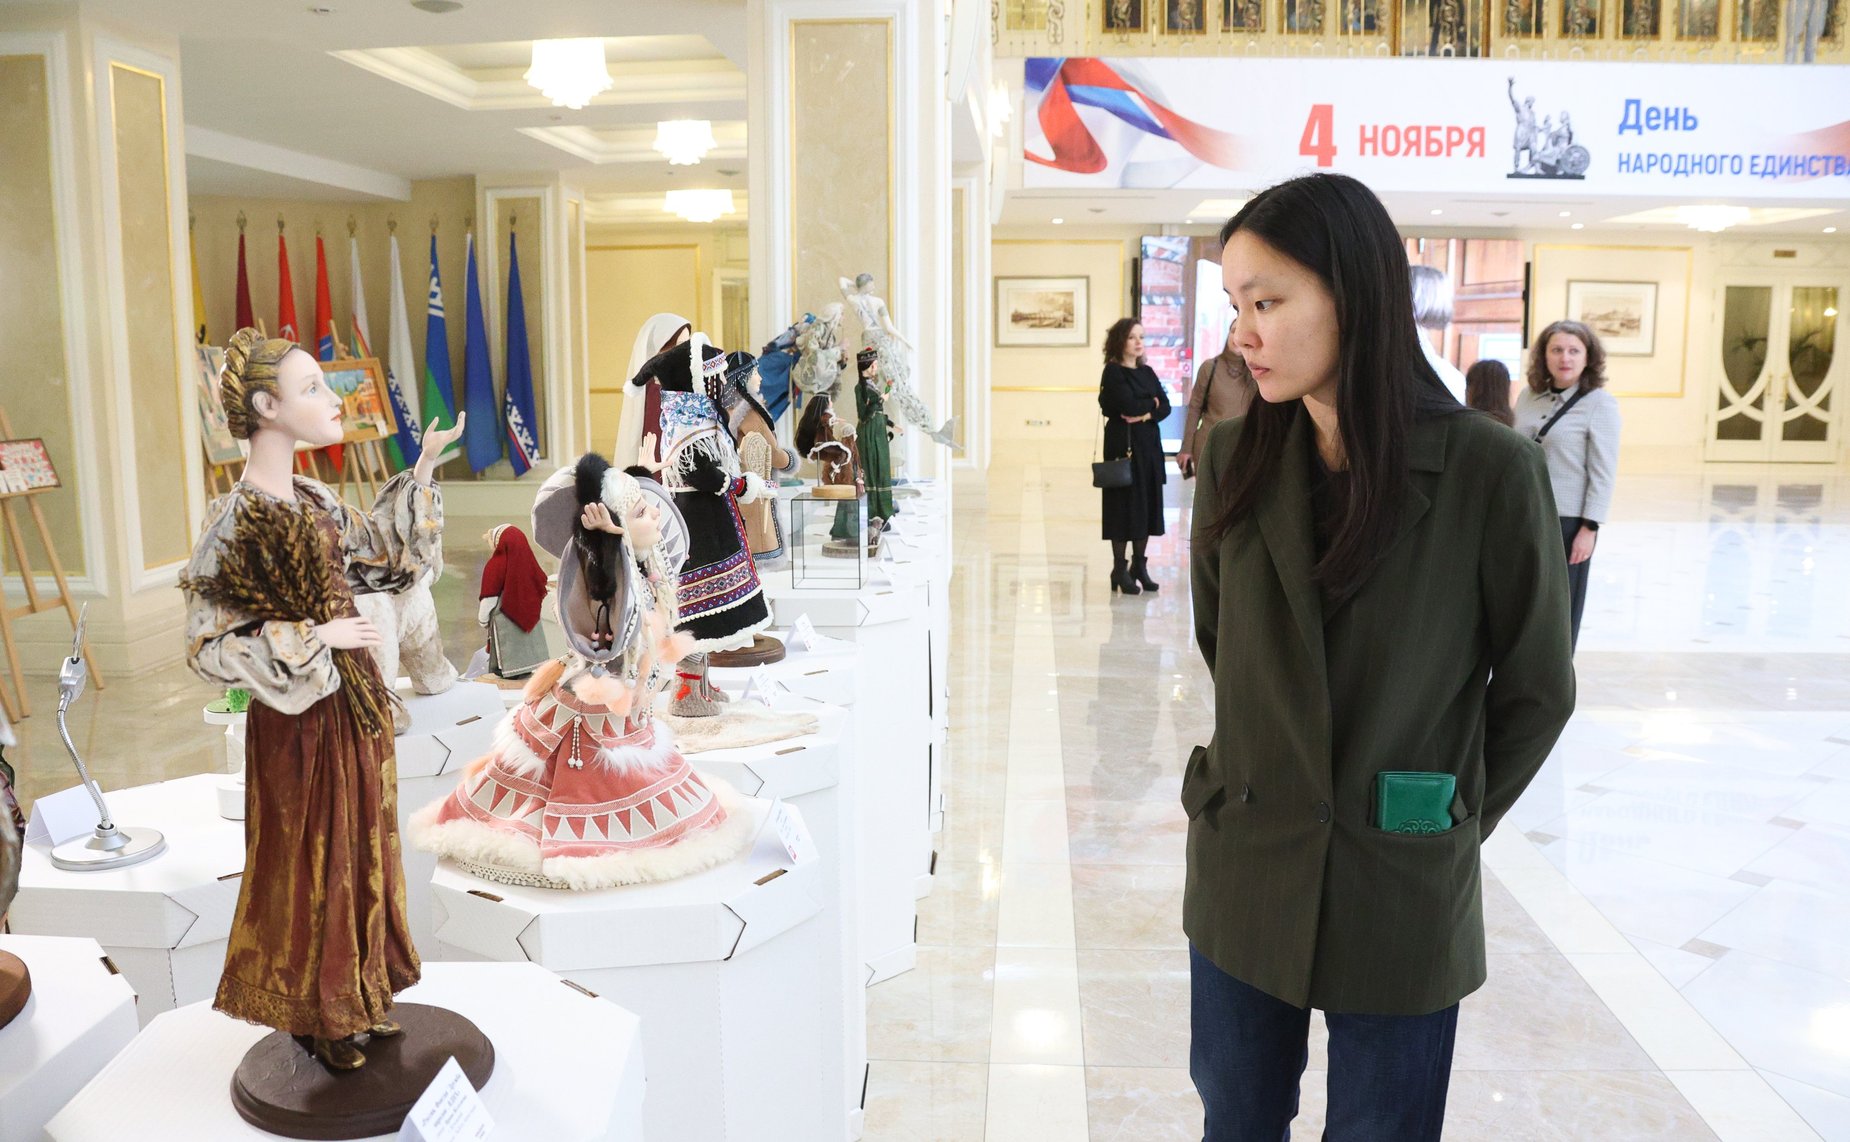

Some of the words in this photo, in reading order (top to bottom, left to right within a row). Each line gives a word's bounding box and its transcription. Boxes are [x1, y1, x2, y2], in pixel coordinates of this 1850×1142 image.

[1299, 104, 1337, 167] 4
[1359, 124, 1486, 158] НОЯБРЯ
[1618, 98, 1699, 136] День
[1617, 153, 1743, 177] НАРОДНОГО
[1749, 154, 1850, 179] ЕДИНСТВ
